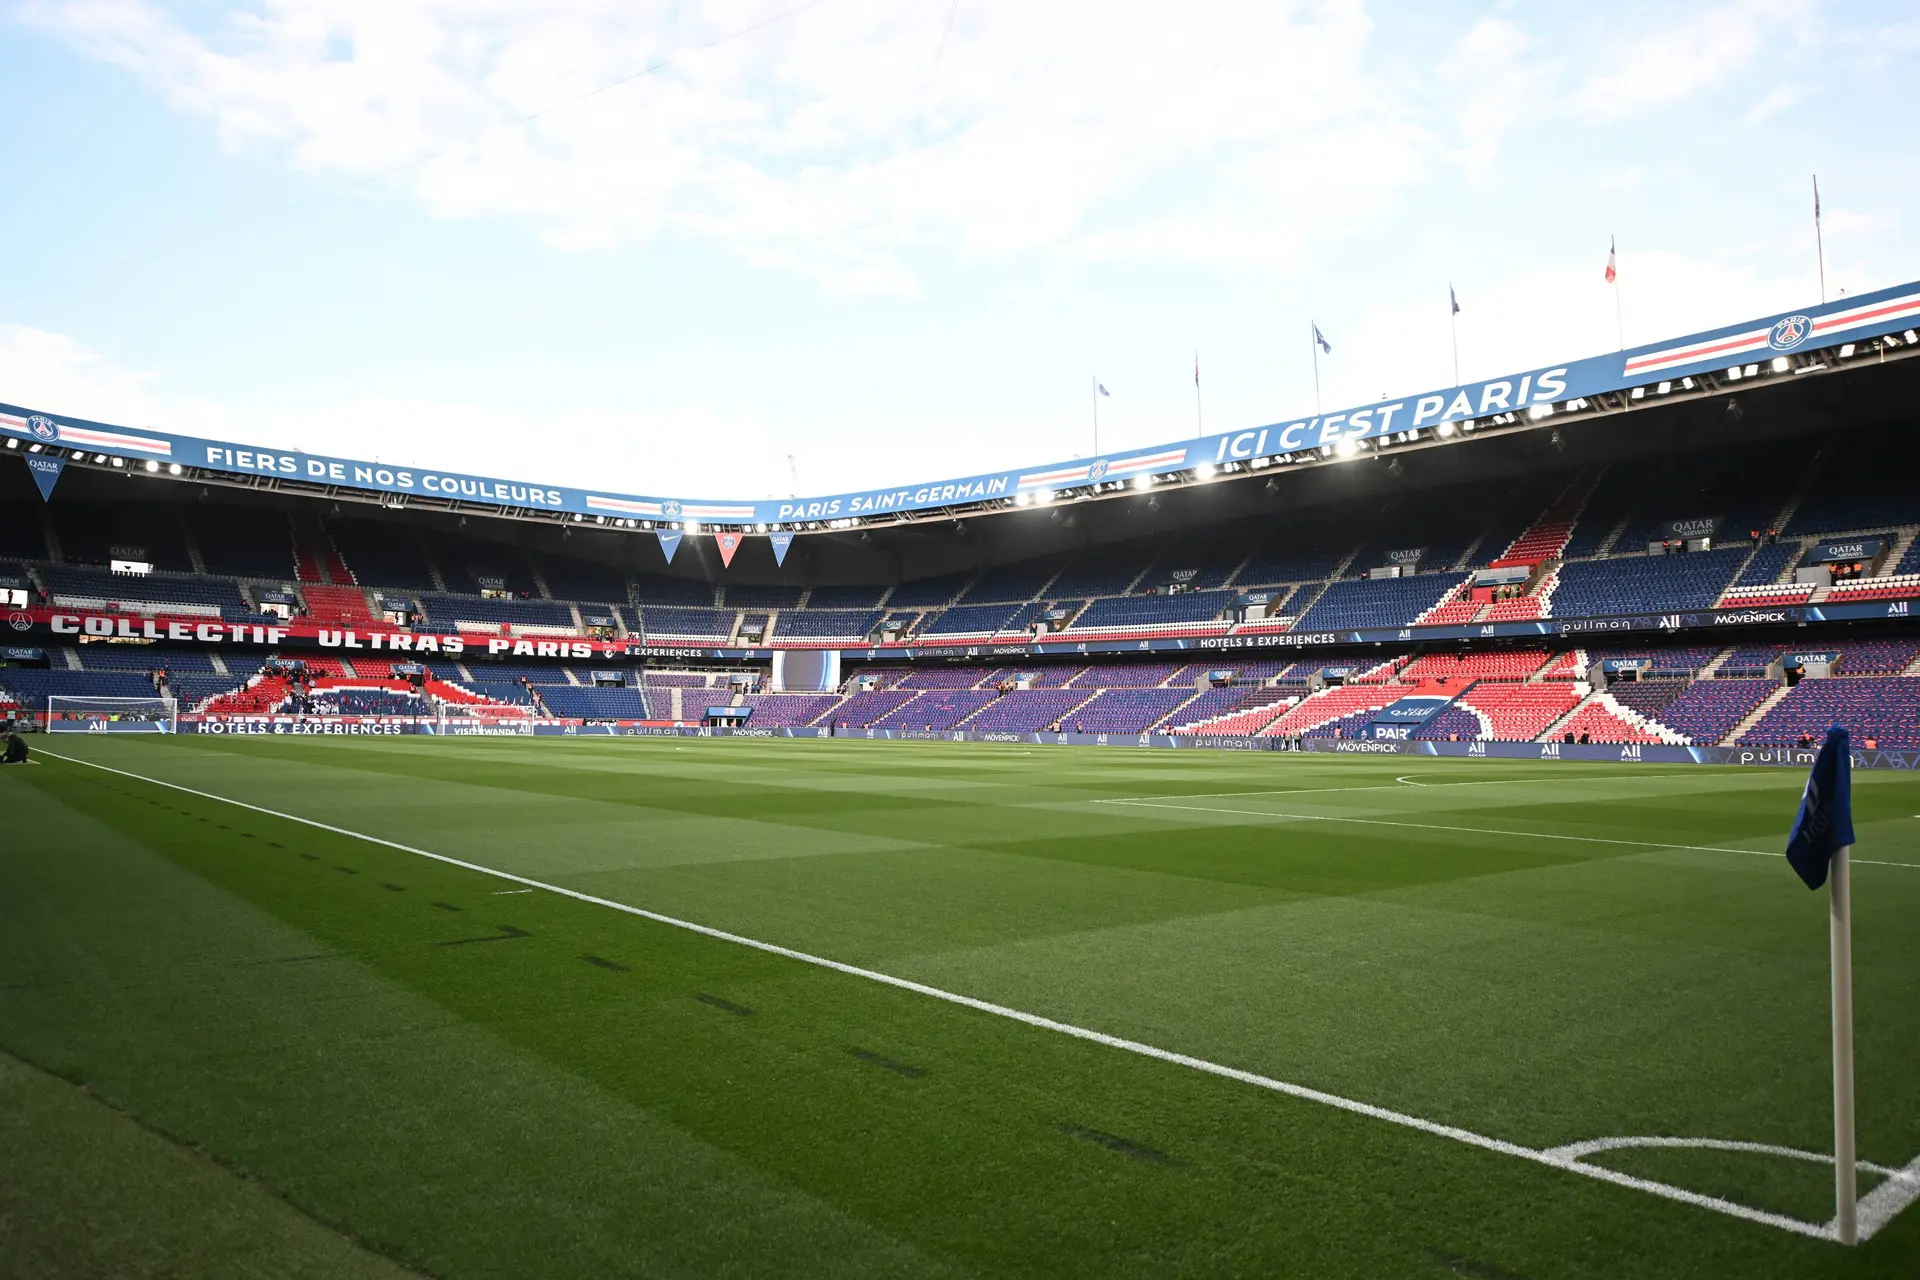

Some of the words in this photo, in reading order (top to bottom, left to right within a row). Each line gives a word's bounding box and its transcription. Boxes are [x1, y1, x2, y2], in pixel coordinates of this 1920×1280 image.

[1776, 317, 1806, 329] PARIS
[1216, 429, 1269, 461] ICI
[1279, 404, 1403, 449] C'EST
[1412, 368, 1568, 426] PARIS
[30, 459, 58, 470] QATAR
[206, 446, 298, 473] FIERS
[307, 459, 346, 480] DE
[355, 467, 414, 488] NOS
[422, 474, 563, 506] COULEURS
[778, 500, 841, 519] PARIS
[848, 476, 1009, 512] SAINT-GERMAIN
[1672, 519, 1713, 533] QATAR
[1391, 549, 1421, 560] QATAR
[1829, 544, 1863, 555] QATAR
[479, 577, 504, 585] QATAR
[1562, 619, 1630, 634] pullman
[1714, 611, 1786, 624] MÖVENPICK
[50, 614, 290, 644] COLLECTIF
[318, 629, 464, 653] ULTRAS
[488, 638, 592, 659] PARIS
[1200, 637, 1242, 648] HOTELS
[1246, 637, 1254, 646] &
[1257, 633, 1335, 646] EXPERIENCES
[634, 648, 702, 657] EXPERIENCES
[1612, 660, 1638, 668] QATAR
[1795, 655, 1827, 664] QATAR
[197, 722, 267, 734] HOTELS
[274, 723, 285, 734] &
[292, 723, 401, 734] EXPERIENCES
[627, 728, 678, 737] pullman
[1376, 728, 1411, 740] PAR
[1195, 738, 1252, 750] pullman
[1336, 740, 1397, 752] MÖVENPICK
